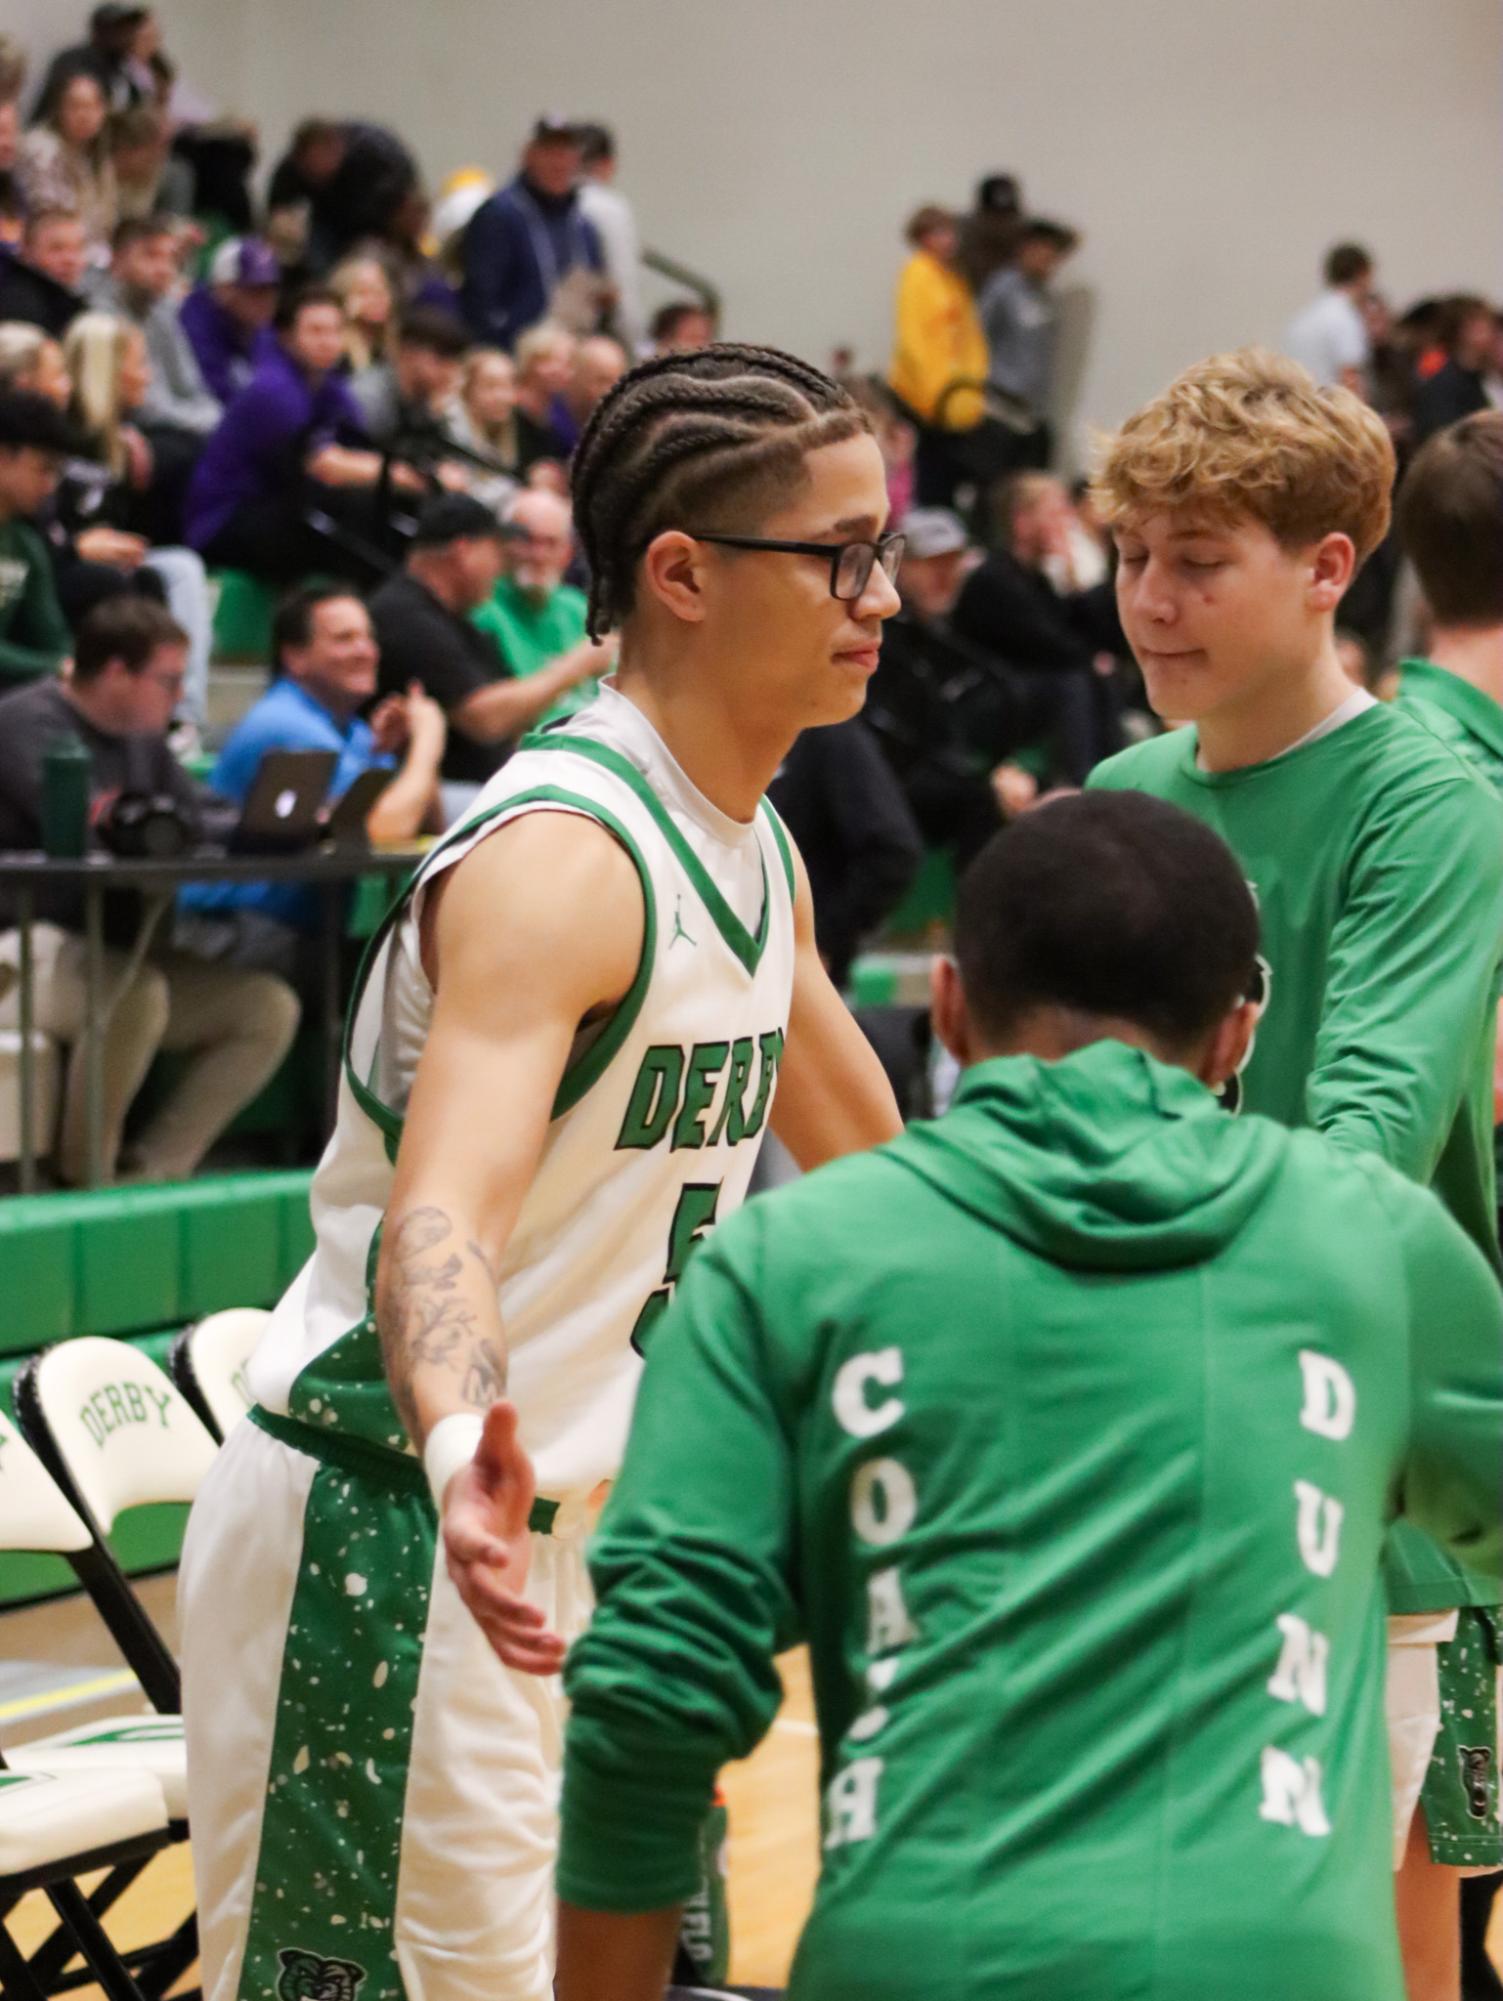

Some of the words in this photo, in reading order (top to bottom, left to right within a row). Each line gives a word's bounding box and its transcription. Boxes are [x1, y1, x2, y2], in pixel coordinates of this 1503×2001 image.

[613, 1026, 785, 1153] DERB
[79, 1380, 171, 1448] DERBY
[1258, 1348, 1357, 1836] DUNN
